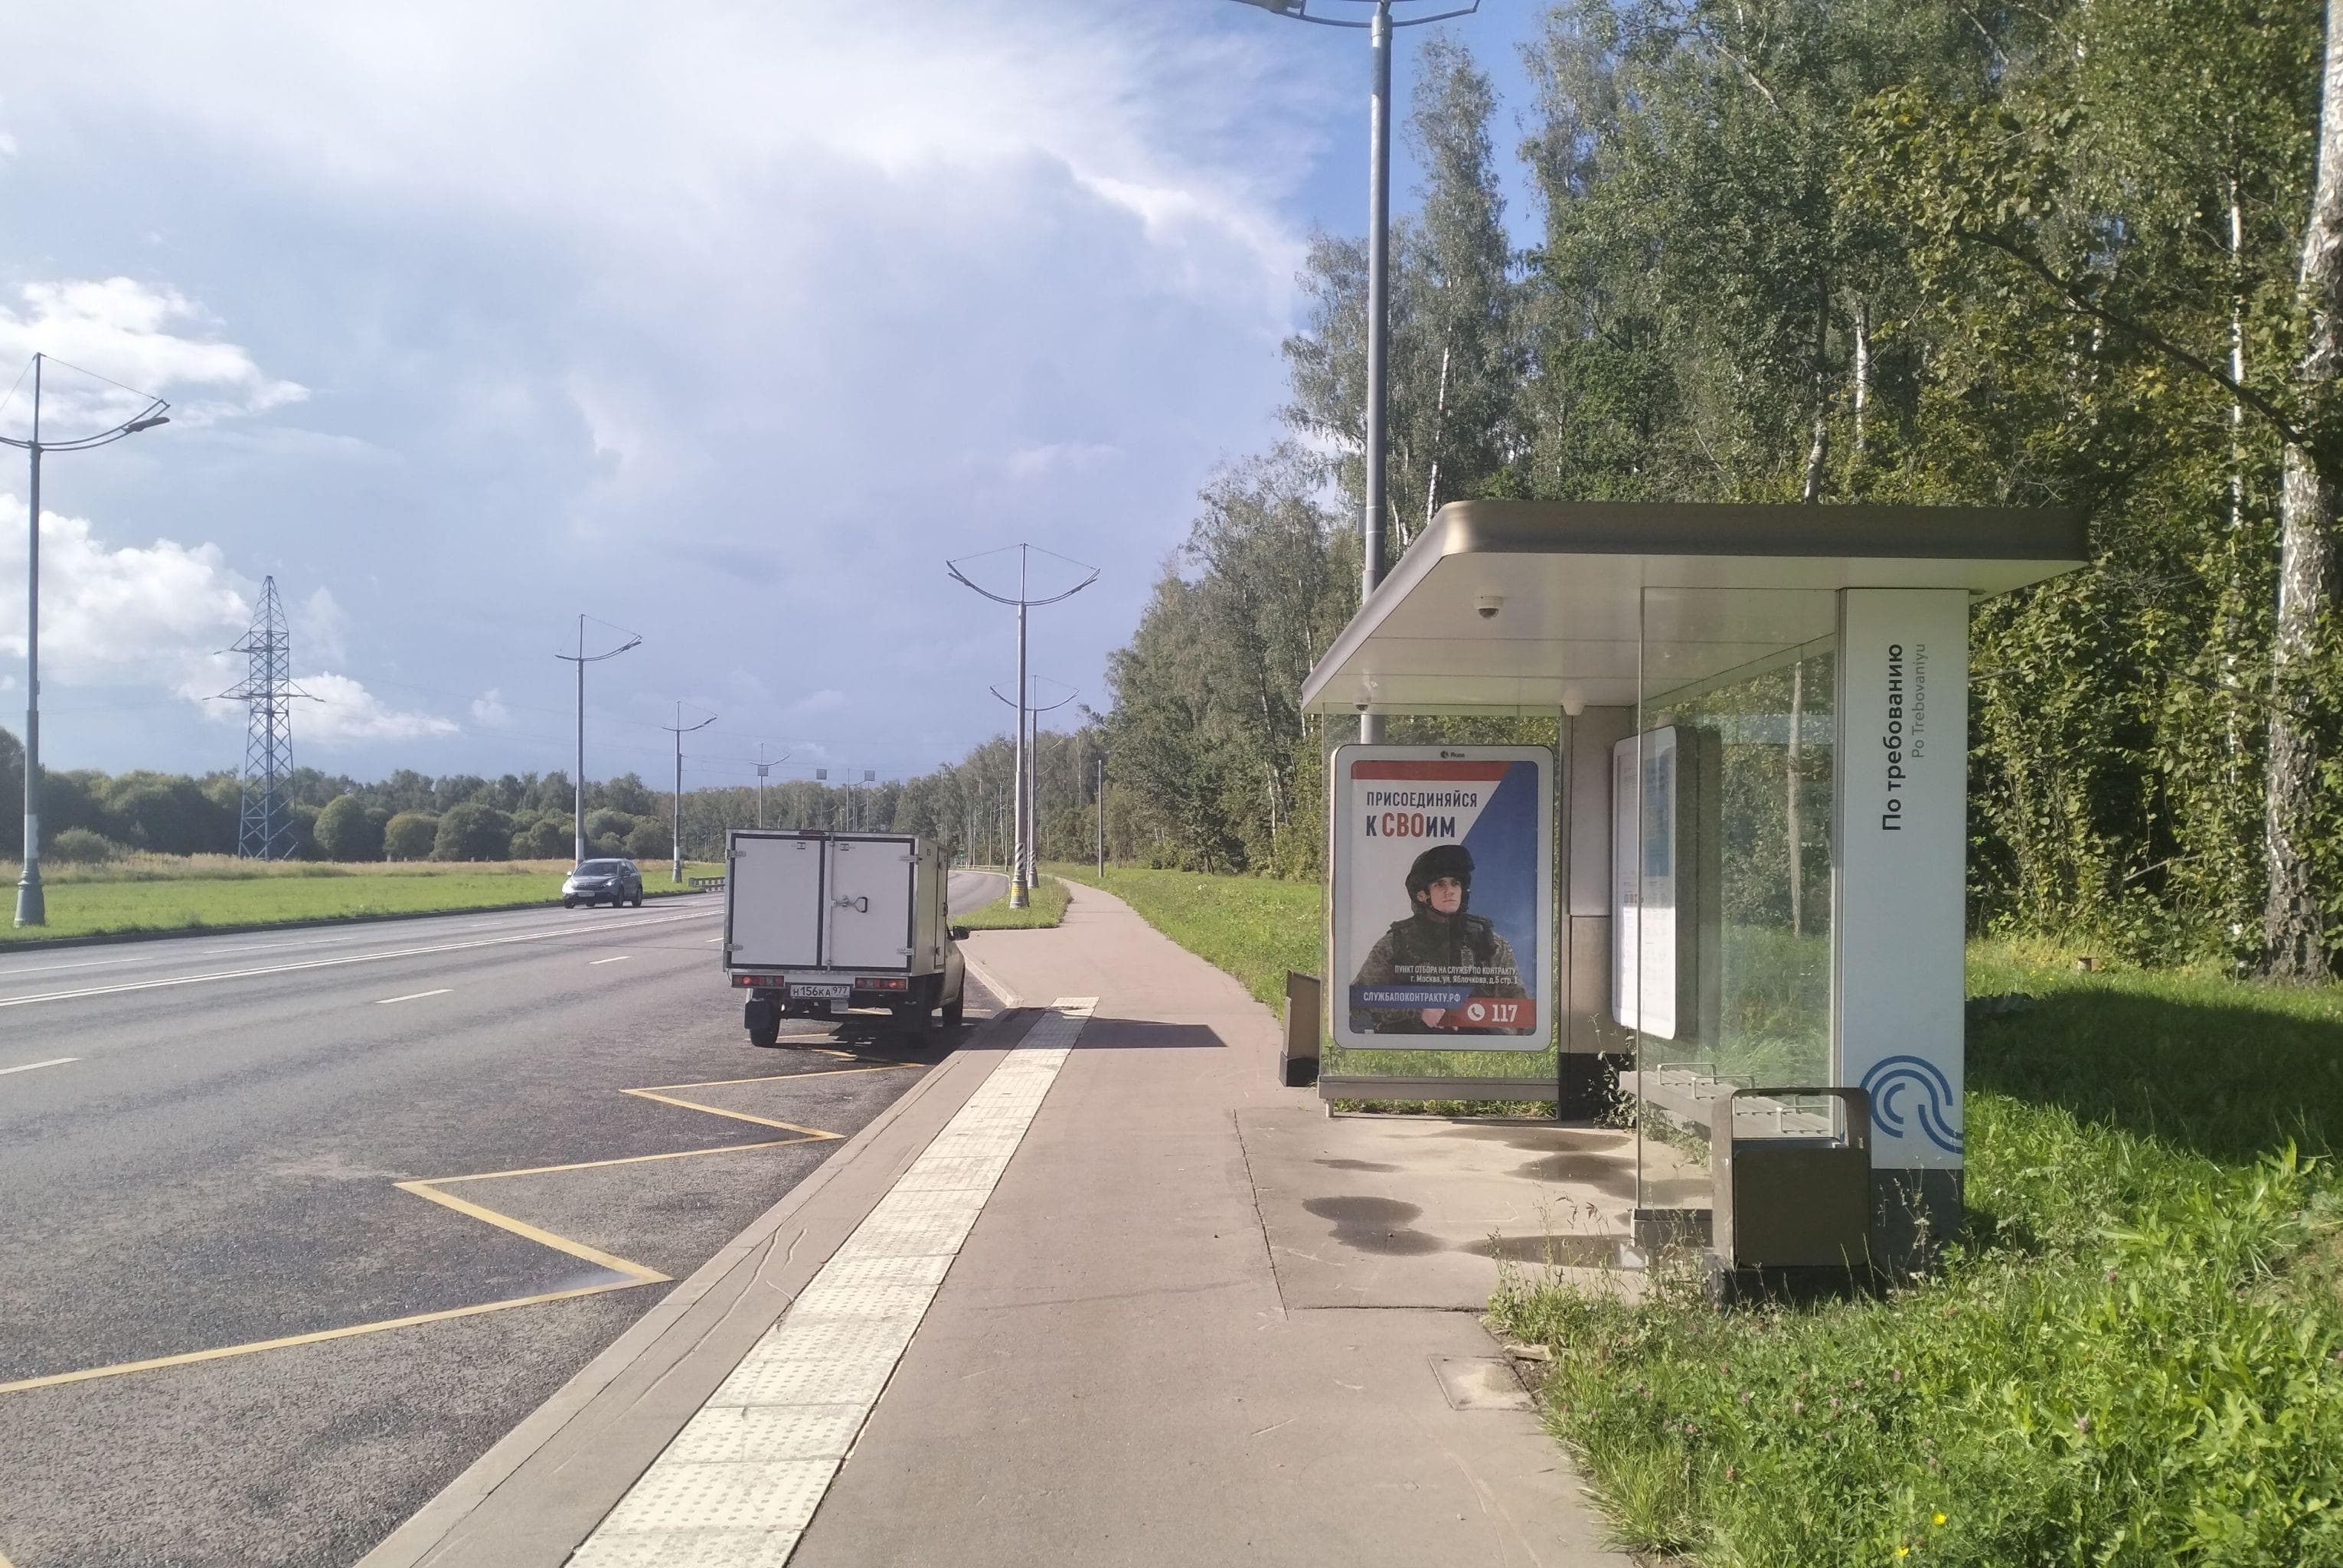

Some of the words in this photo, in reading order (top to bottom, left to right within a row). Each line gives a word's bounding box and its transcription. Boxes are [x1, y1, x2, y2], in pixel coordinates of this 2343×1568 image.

[1911, 643, 1928, 737] Trebovaniyu
[1882, 643, 1907, 792] требованию
[1911, 739, 1924, 758] Po
[1366, 789, 1478, 808] ПРИСОЕДИНЯЙСЯ
[1882, 799, 1902, 831] По
[1366, 815, 1377, 837] К
[1381, 812, 1456, 838] СВОИМ
[1394, 965, 1414, 973] ПУНКТ
[1438, 965, 1446, 974] НА
[1447, 965, 1472, 975] СЛУЖБУ
[1472, 966, 1481, 975] ПО
[1364, 991, 1461, 1003] СЛУЖБАПОКОНТРАКТУ.РФ
[1492, 1004, 1518, 1022] 117
